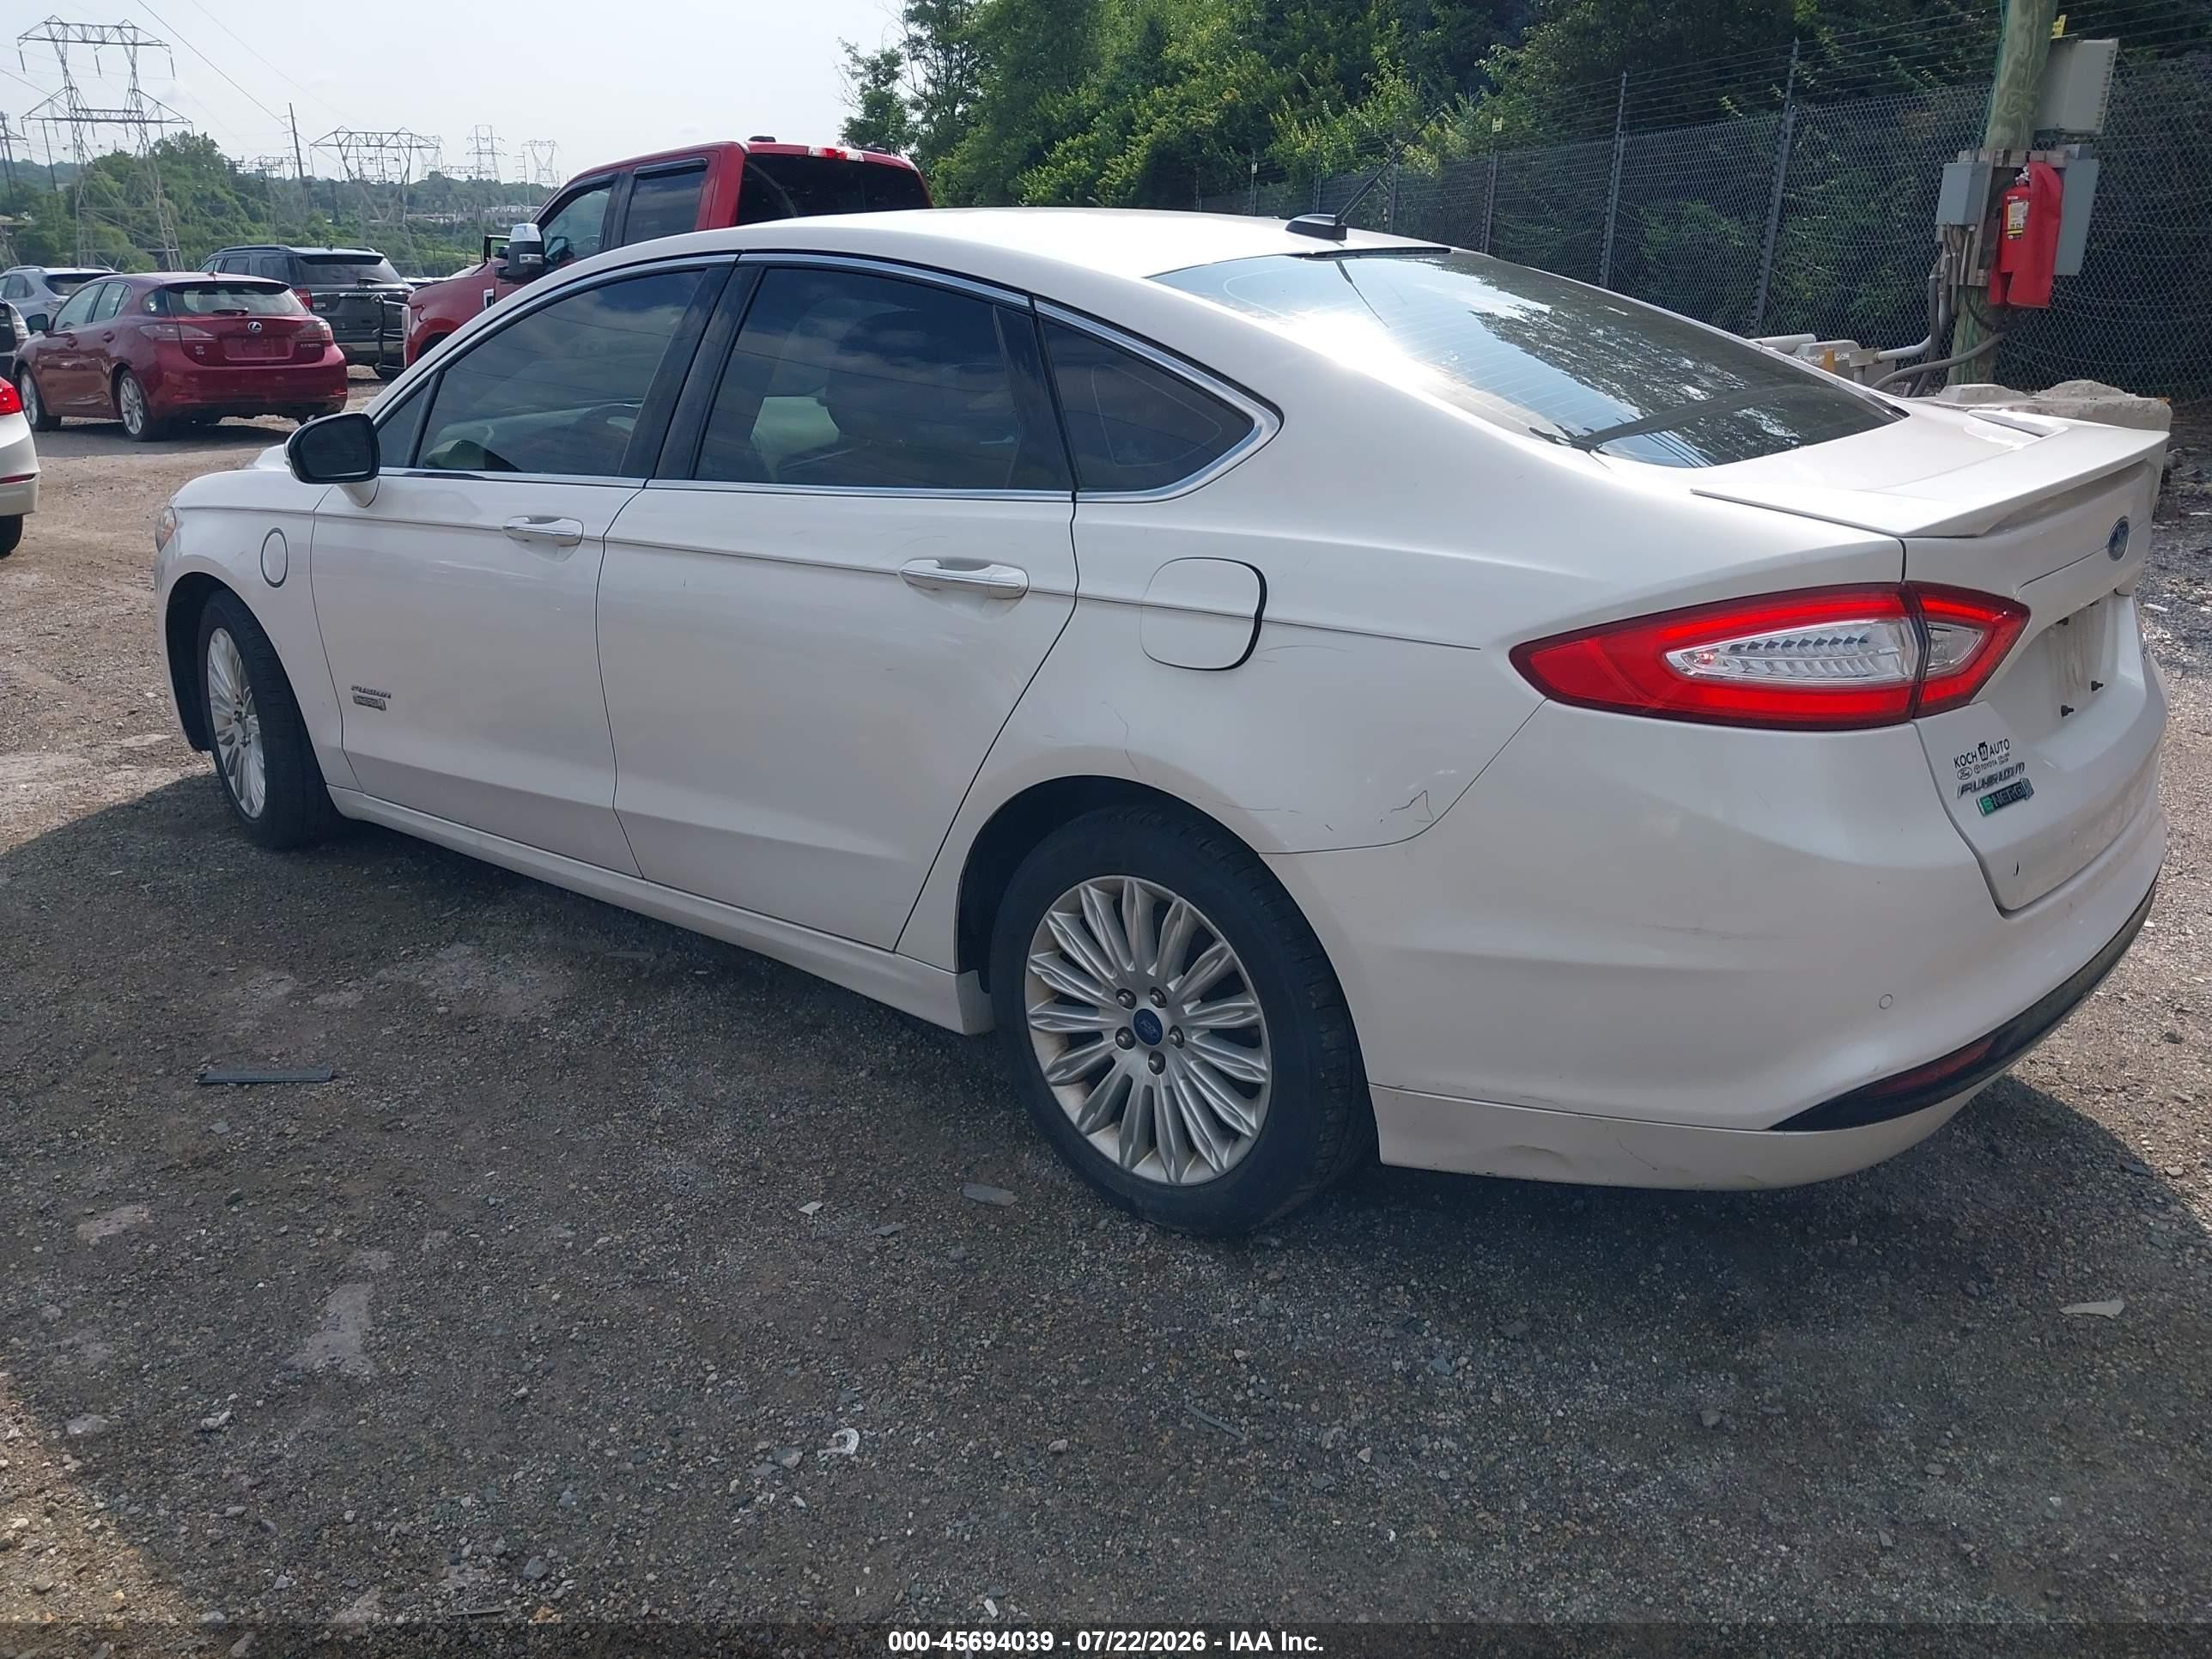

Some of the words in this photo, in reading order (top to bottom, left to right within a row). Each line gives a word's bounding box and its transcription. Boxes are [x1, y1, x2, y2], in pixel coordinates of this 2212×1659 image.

[1954, 750, 1978, 769] KOCH
[1990, 738, 2010, 757] AUTO
[1981, 760, 1997, 770] TOYOTA
